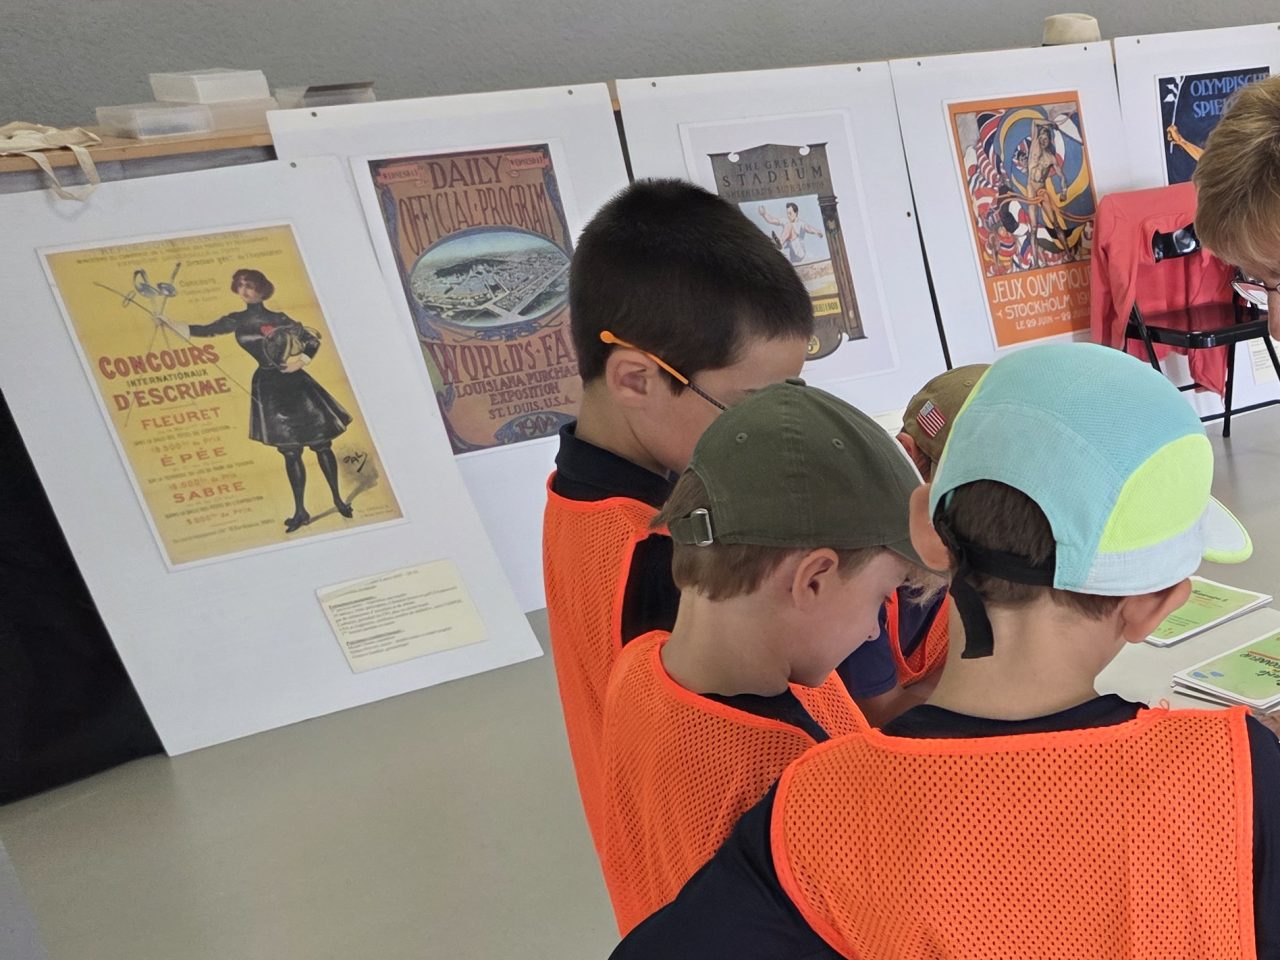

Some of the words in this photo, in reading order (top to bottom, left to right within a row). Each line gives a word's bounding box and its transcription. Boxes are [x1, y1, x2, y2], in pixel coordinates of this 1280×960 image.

[1190, 72, 1269, 97] OLYMPISCH
[1193, 98, 1225, 119] SPIE
[428, 155, 503, 190] DAILY
[722, 165, 823, 188] STADIUM
[737, 162, 760, 172] THE
[765, 158, 804, 169] GREAT
[399, 190, 476, 256] OFFICIAL
[481, 182, 556, 241] PROGRAM
[992, 278, 1026, 304] JEUX
[1026, 266, 1091, 298] OLYMPIQU
[1005, 294, 1073, 320] STOCKHOLM
[98, 344, 220, 380] CONCOURS
[423, 339, 537, 386] WORLD'S
[538, 329, 577, 367] FA
[127, 369, 209, 388] INTERNATIONAUX
[455, 373, 526, 398] LOUISIANA
[526, 364, 579, 386] PURCHAS
[113, 377, 231, 412] D'ESCRIME
[488, 381, 561, 406] EXPOSITION
[141, 407, 221, 430] FLEURET
[160, 446, 228, 467] ÉPÉE
[173, 481, 246, 503] SABRE
